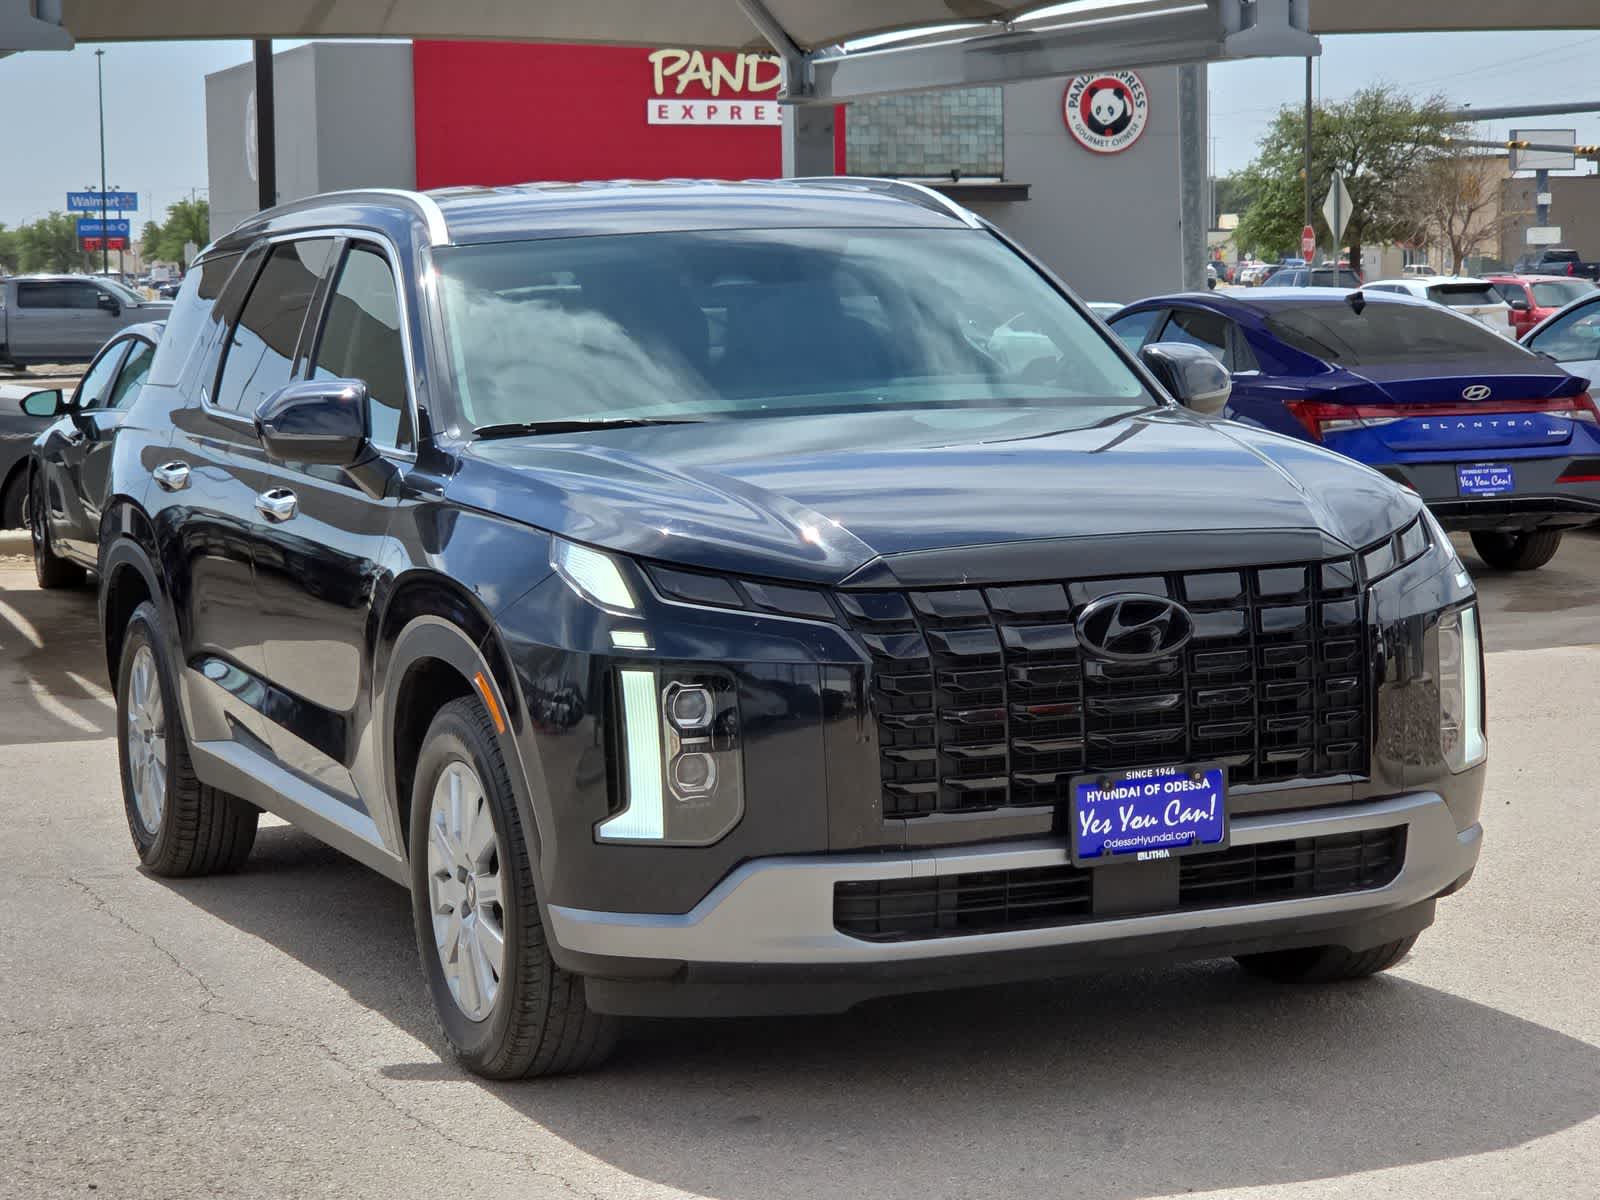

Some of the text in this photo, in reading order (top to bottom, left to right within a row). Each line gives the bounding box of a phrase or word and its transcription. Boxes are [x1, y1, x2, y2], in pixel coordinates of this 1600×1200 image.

[648, 49, 782, 96] PAND
[1068, 71, 1146, 108] PAND PRESS
[657, 105, 783, 120] EXPRE
[1075, 123, 1139, 147] GOURMET CHINESE
[1422, 419, 1533, 430] ELANTRA
[1460, 473, 1512, 487] Yes You Can!
[1126, 767, 1176, 781] SINCE 1946
[1086, 778, 1211, 803] HYUNDAI OF ODESSA
[1079, 793, 1217, 837] Yes You Can!
[1103, 830, 1196, 849] OdessaHyundai.com
